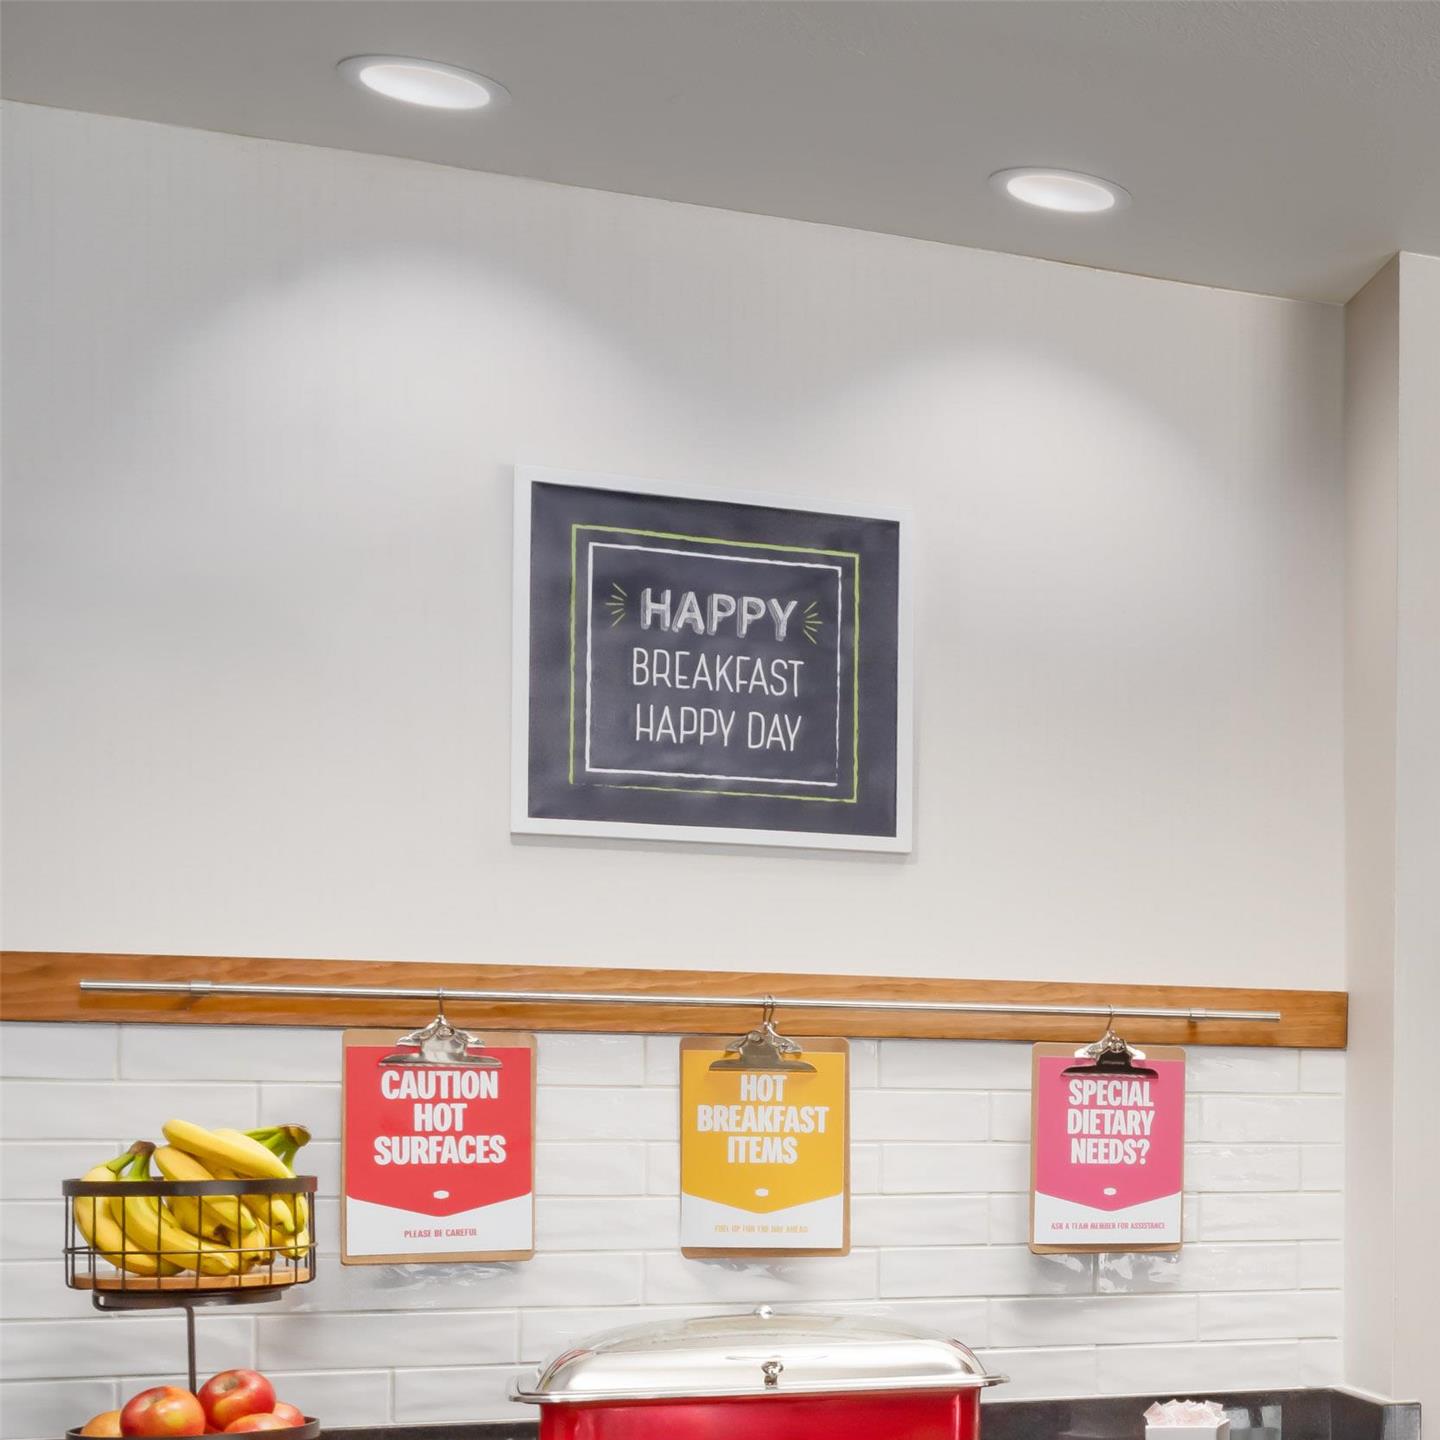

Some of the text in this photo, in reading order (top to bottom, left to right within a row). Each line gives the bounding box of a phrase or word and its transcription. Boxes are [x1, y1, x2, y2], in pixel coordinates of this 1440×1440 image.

[640, 587, 798, 641] HAPPY
[632, 647, 805, 698] BREAKFAST
[635, 704, 802, 752] HAPPY DAY
[381, 1070, 498, 1100] CAUTION
[740, 1074, 788, 1102] HOT
[1068, 1079, 1154, 1107] SPECIAL
[413, 1102, 468, 1132] HOT
[696, 1104, 829, 1134] BREAKFAST
[1067, 1108, 1156, 1136] DIETARY
[373, 1134, 507, 1166] SURFACES
[727, 1136, 798, 1164] ITEMS
[1070, 1138, 1151, 1165] NEEDS?
[404, 1228, 477, 1238] PLEASE BE CAREFUL
[1065, 1222, 1070, 1230] A
